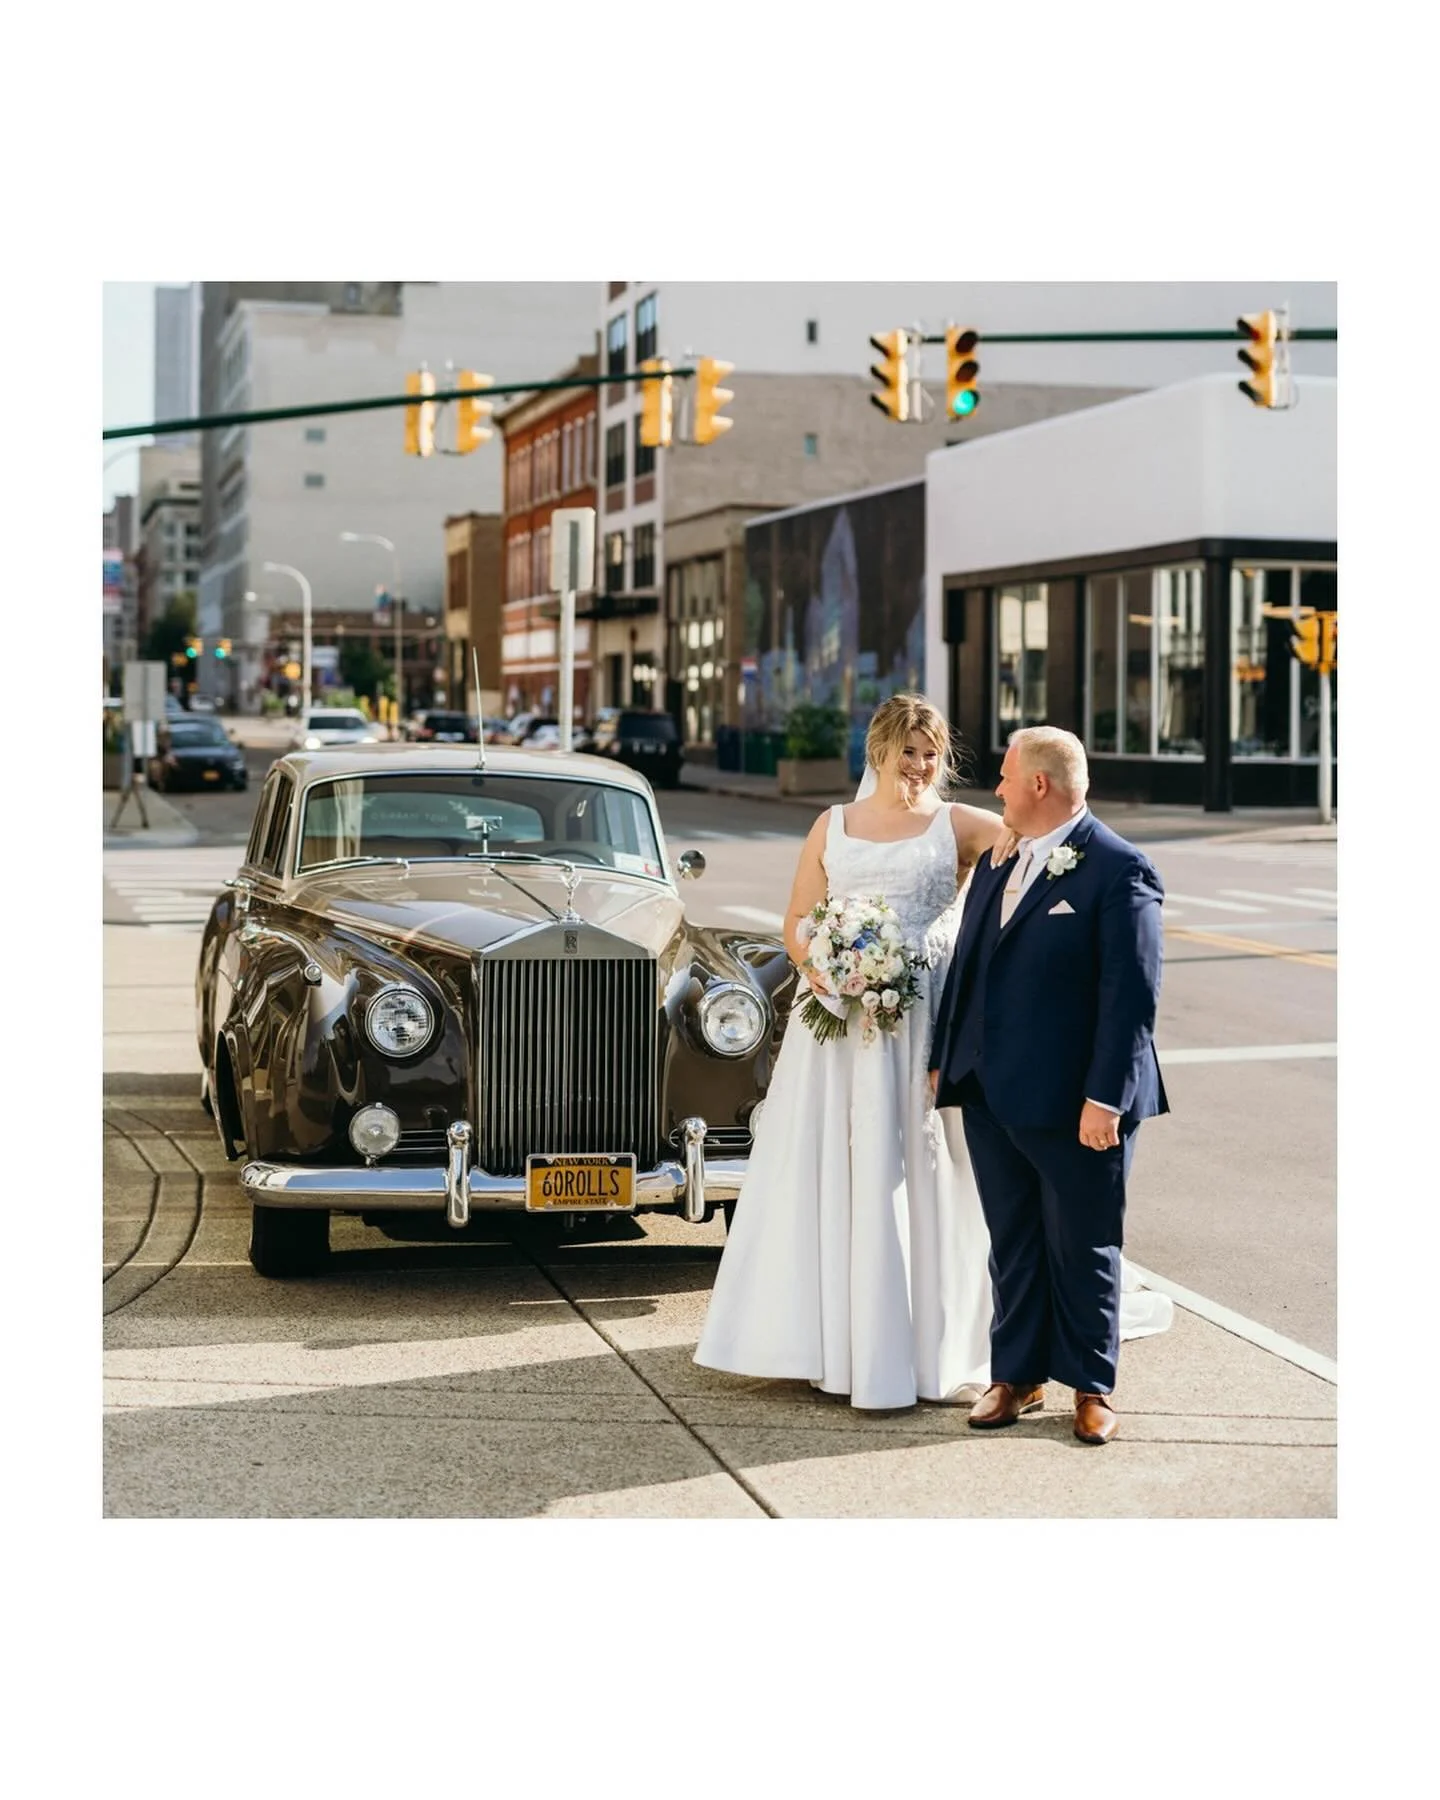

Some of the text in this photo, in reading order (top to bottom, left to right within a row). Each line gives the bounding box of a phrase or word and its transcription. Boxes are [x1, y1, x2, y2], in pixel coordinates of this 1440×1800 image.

[554, 1157, 609, 1166] NEW YORK
[542, 1169, 620, 1197] 60ROLLS
